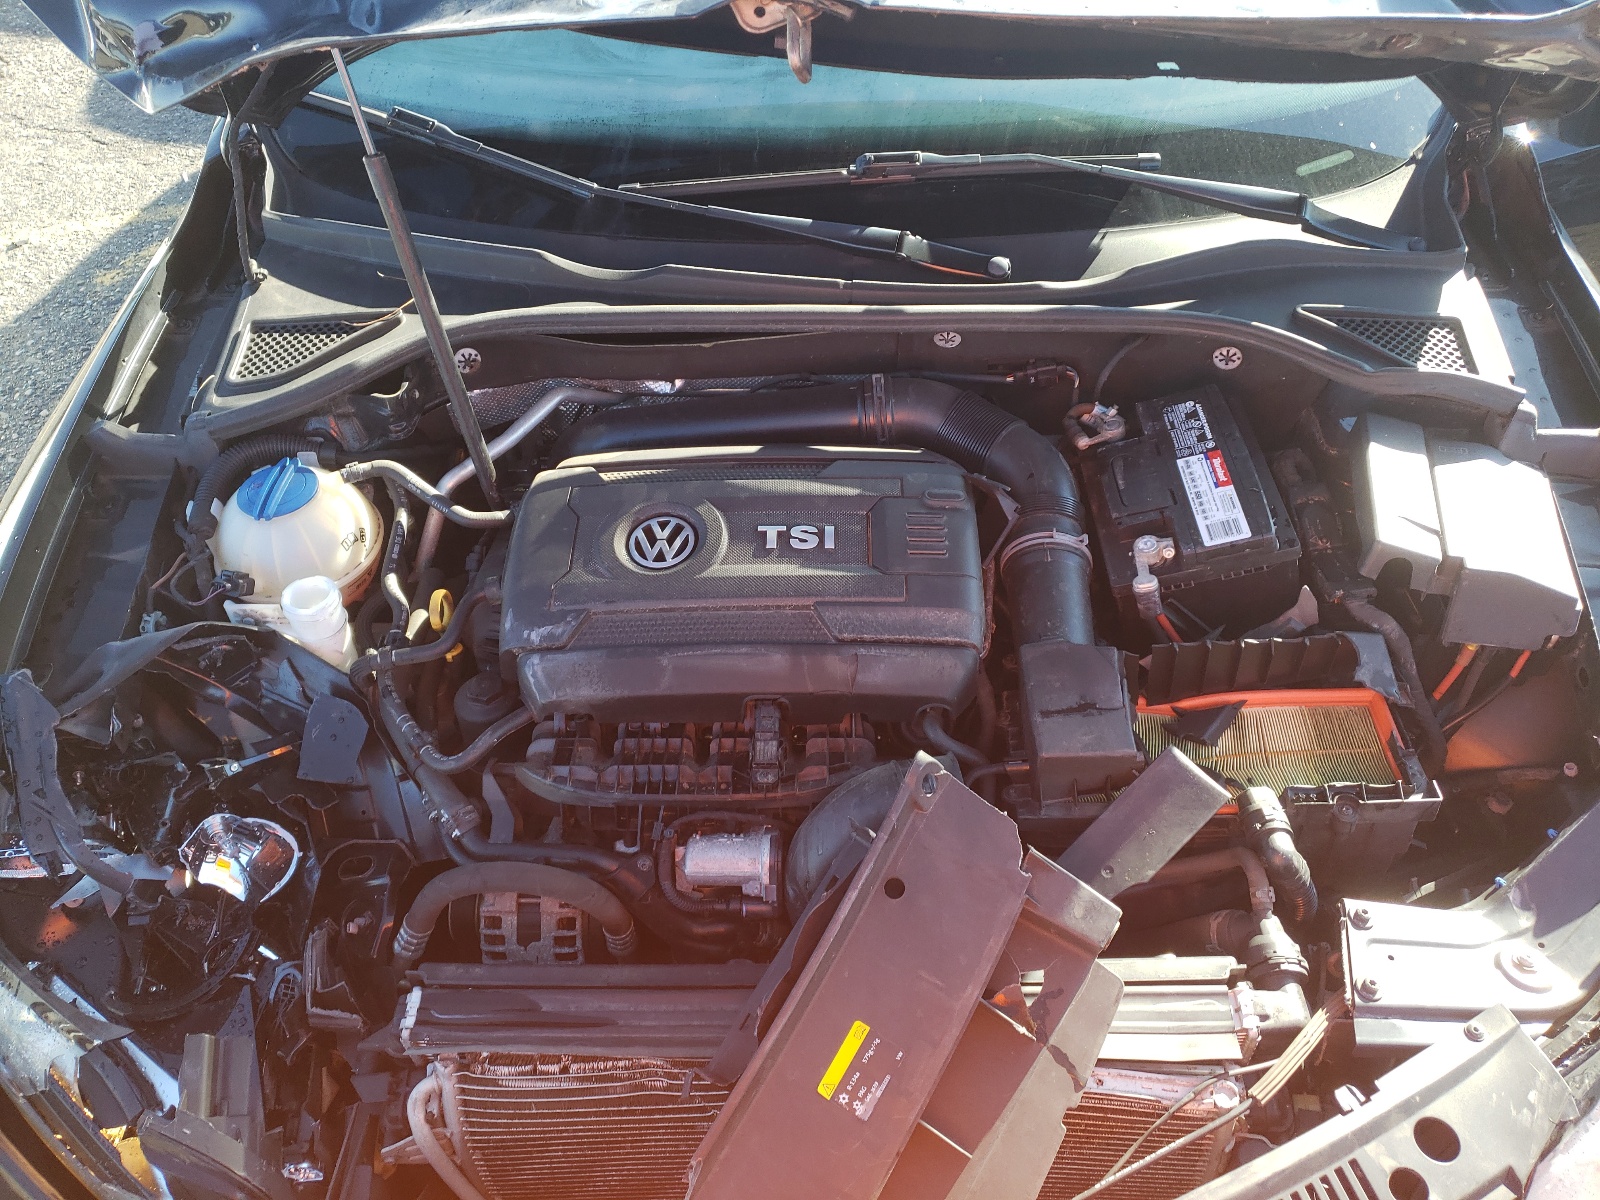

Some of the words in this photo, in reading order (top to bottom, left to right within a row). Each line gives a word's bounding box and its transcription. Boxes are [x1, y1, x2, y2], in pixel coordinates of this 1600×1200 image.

[1212, 456, 1228, 482] Duralast
[757, 525, 836, 550] TSI
[895, 1051, 903, 1060] VW
[847, 1072, 860, 1091] R-134a
[858, 1086, 866, 1098] PAG
